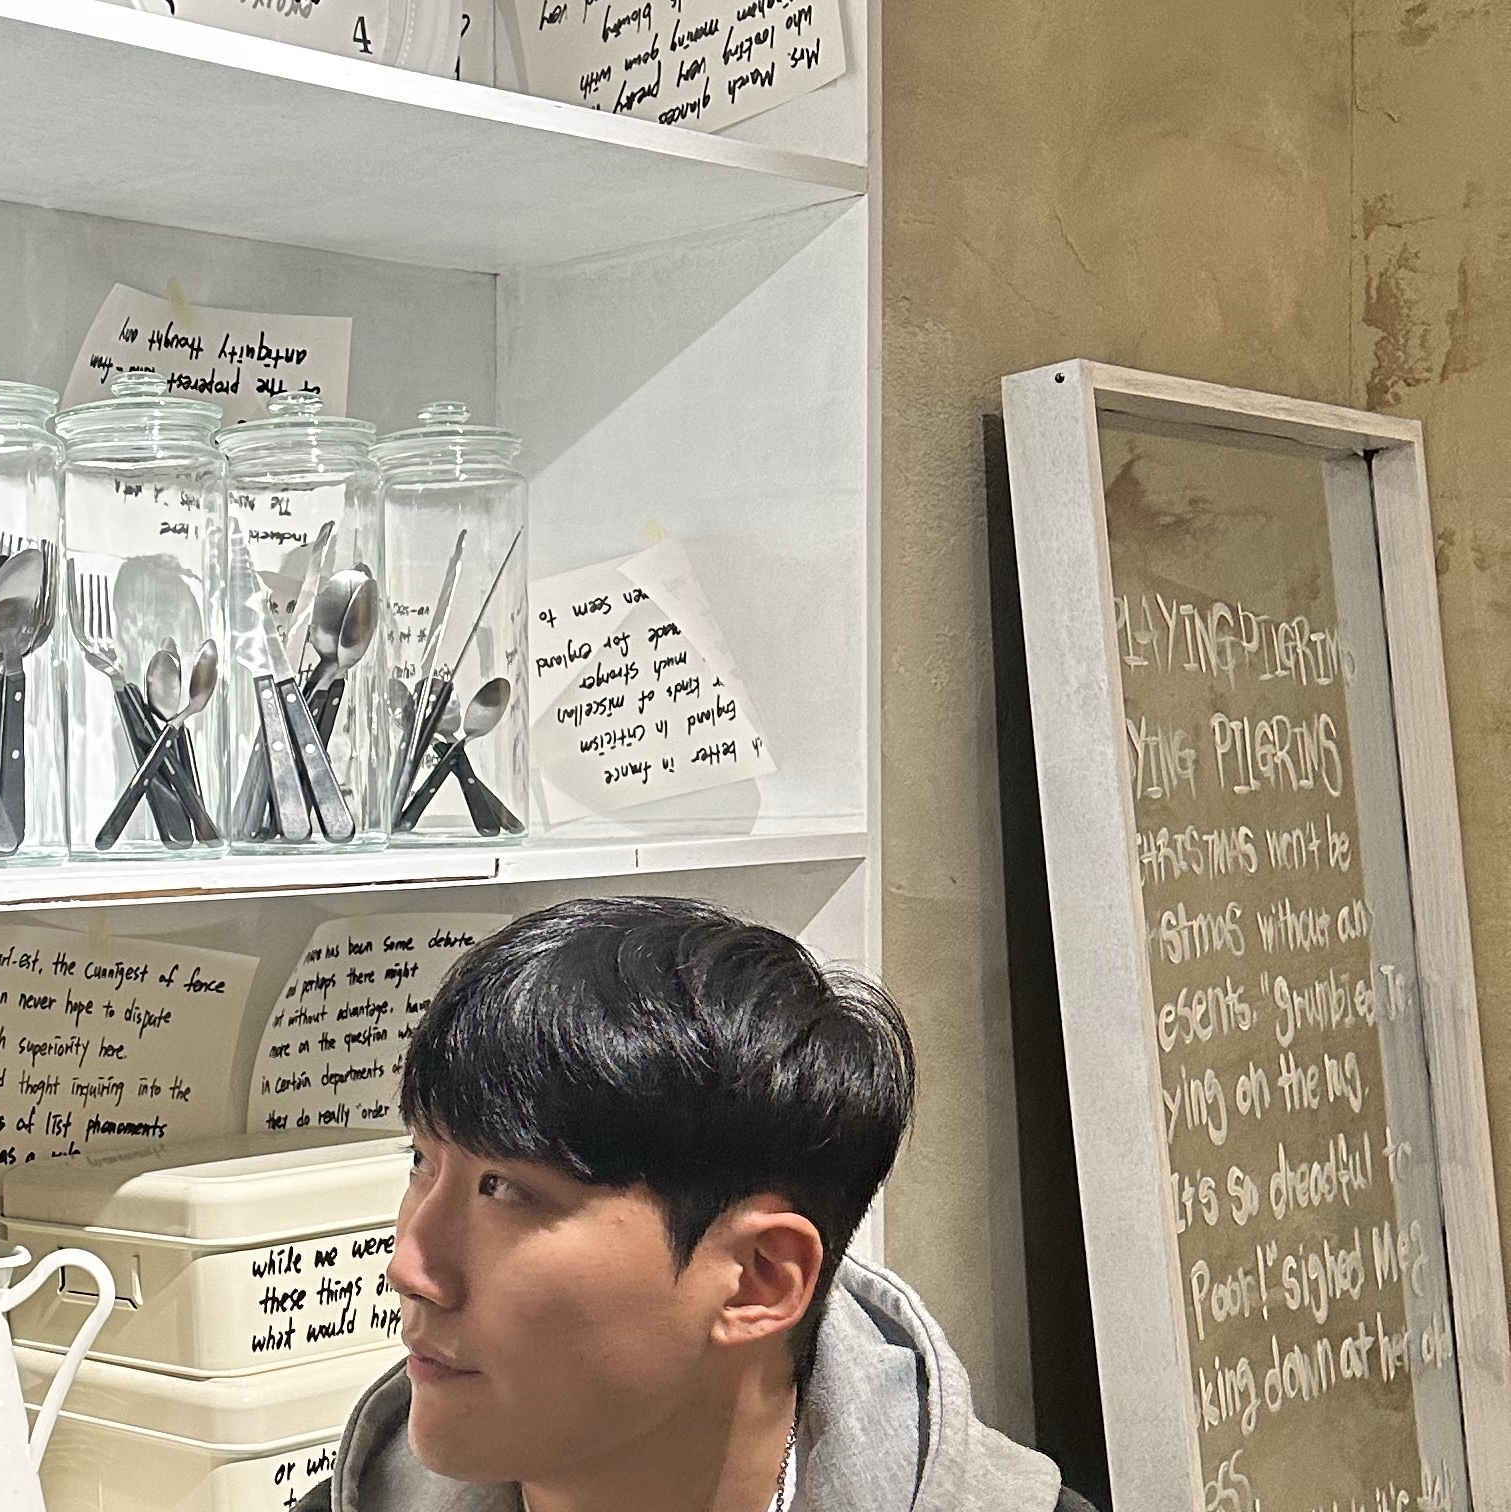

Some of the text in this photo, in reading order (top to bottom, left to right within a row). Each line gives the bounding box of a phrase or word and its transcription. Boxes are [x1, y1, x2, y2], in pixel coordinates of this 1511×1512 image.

[728, 62, 775, 104] March
[539, 609, 557, 628] to
[603, 632, 630, 657] for
[654, 651, 686, 681] much
[691, 740, 736, 765] better
[1327, 814, 1351, 872] be
[18, 988, 93, 1028] never hope
[1236, 1052, 1320, 1119] on the
[259, 1277, 363, 1315] these things
[252, 1306, 356, 1352] what would
[1264, 1335, 1336, 1412] down
